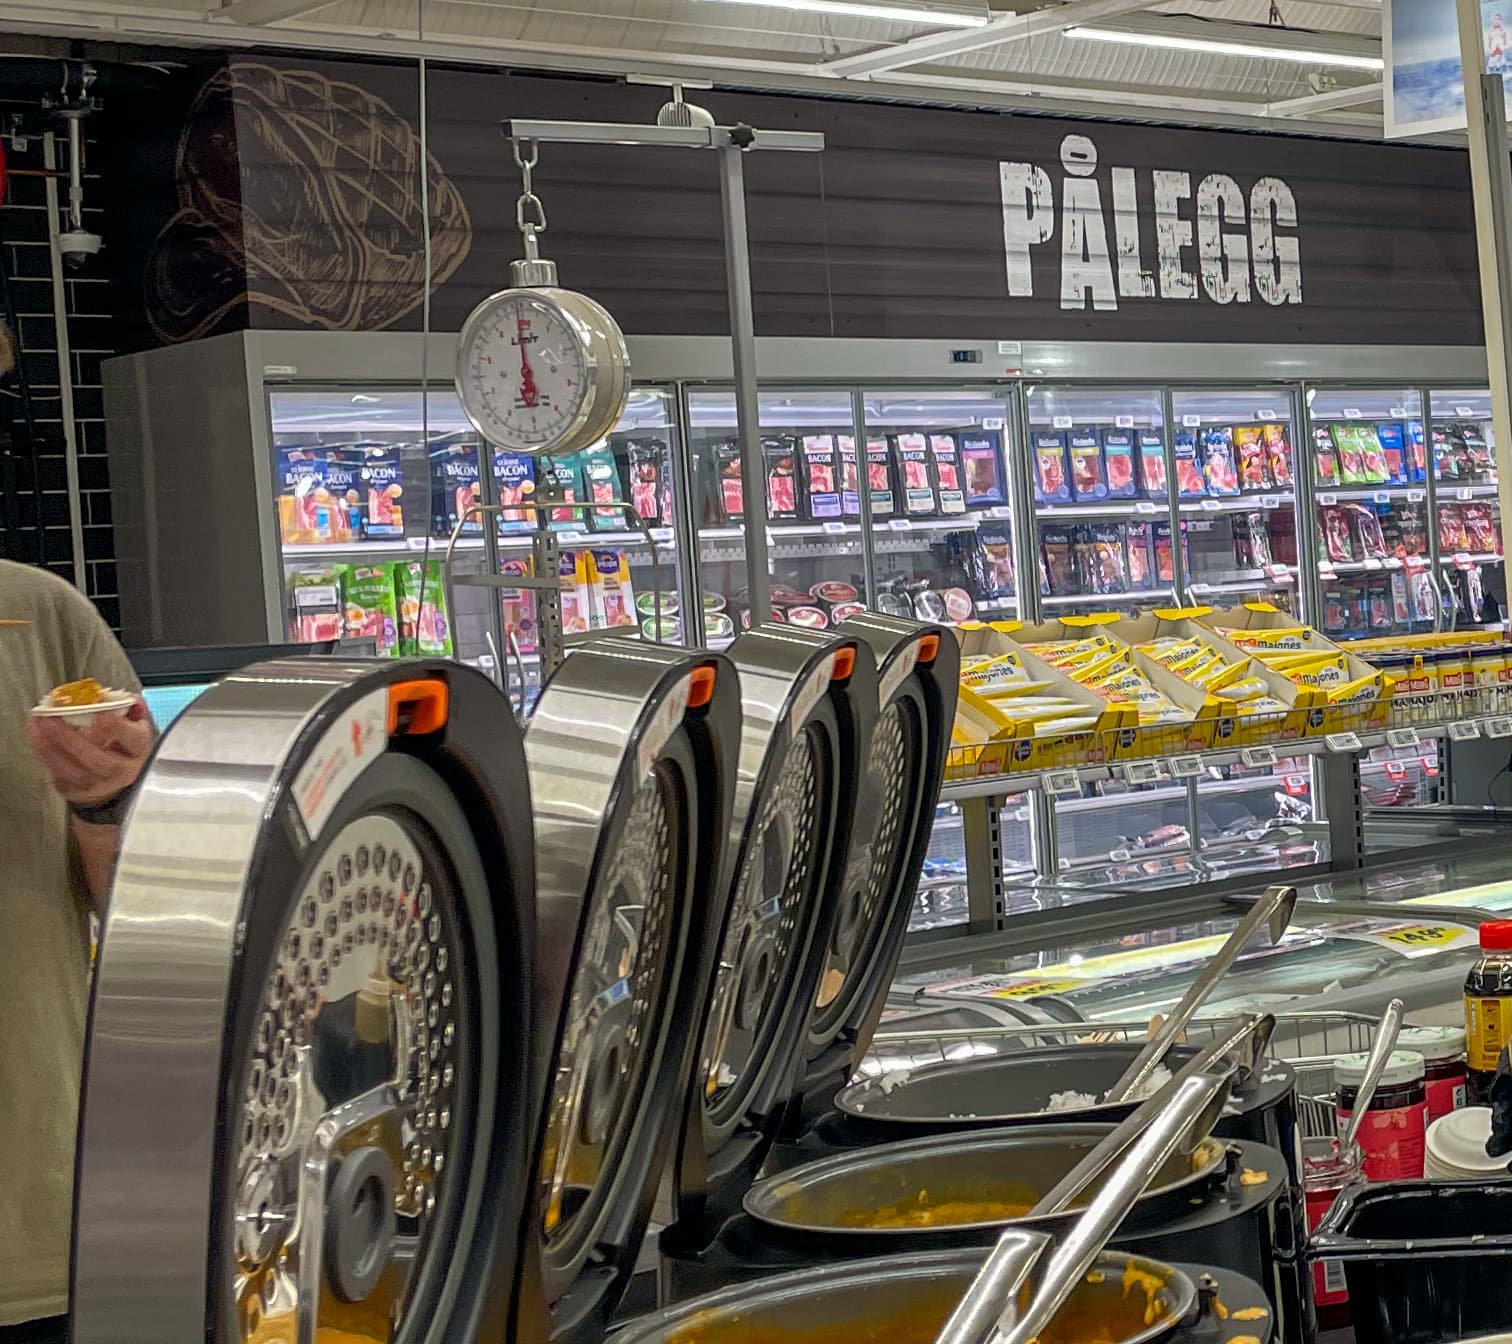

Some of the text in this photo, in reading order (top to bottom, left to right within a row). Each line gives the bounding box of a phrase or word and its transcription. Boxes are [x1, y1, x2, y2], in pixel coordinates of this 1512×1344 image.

[999, 134, 1303, 312] PÅLEGG
[494, 464, 528, 477] BACON
[328, 473, 352, 484] ACON
